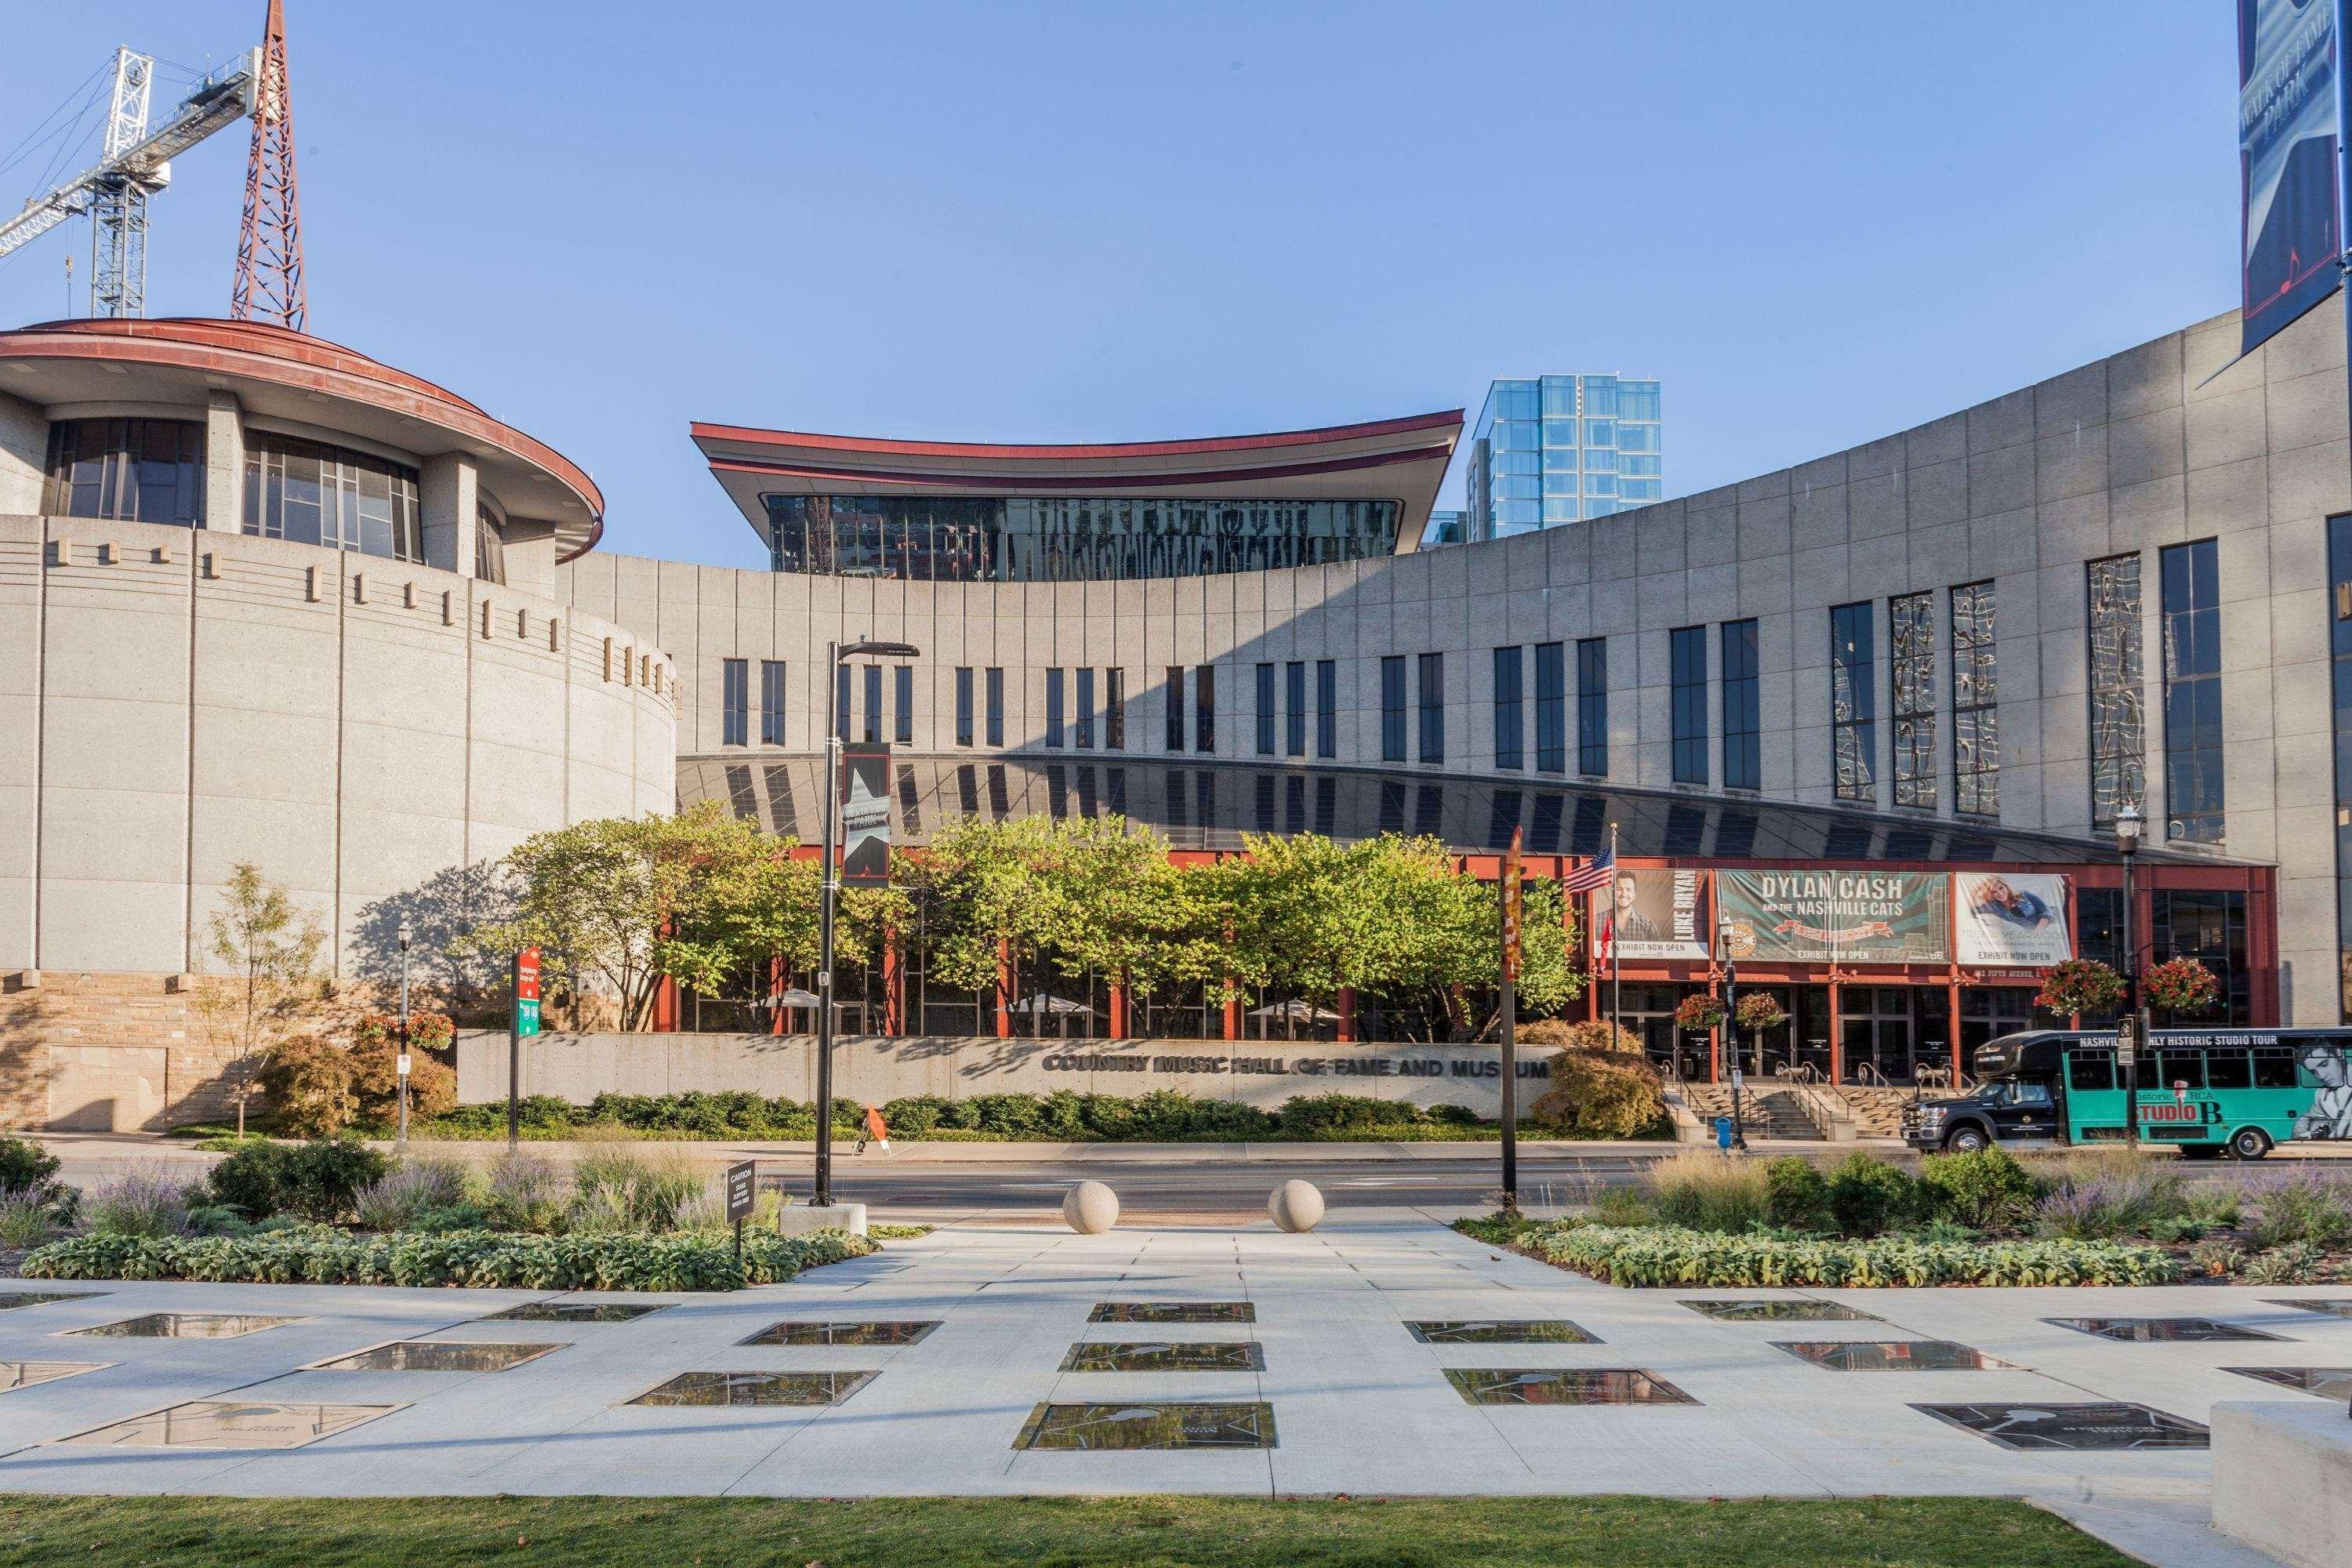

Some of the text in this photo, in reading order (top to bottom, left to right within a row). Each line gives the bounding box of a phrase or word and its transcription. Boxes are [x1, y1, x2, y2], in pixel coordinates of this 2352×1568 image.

[2239, 75, 2274, 132] WALK
[2263, 60, 2309, 144] PARK
[1762, 877, 1902, 899] DYLAN CASH
[1674, 869, 1695, 940] LUKE BRYAN
[1780, 903, 1793, 912] THE
[1797, 902, 1867, 916] NASHVILLE
[1870, 902, 1903, 916] CATS
[1797, 950, 1828, 960] EXHIBIT
[1849, 951, 1869, 960] OPEN
[2009, 952, 2027, 960] NOW
[2029, 953, 2051, 961] OPEN
[2080, 1037, 2118, 1047] NASHVIL
[2148, 1036, 2165, 1046] NLY
[2167, 1036, 2212, 1046] HISTORIC
[2215, 1036, 2249, 1045] STUDIO
[2252, 1035, 2278, 1045] TOUR
[1043, 1054, 1549, 1078] COUNTRY MUSIC HALL OF FAME AND MUSUM
[2136, 1091, 2215, 1101] istoric RCA
[2198, 1102, 2223, 1125] B
